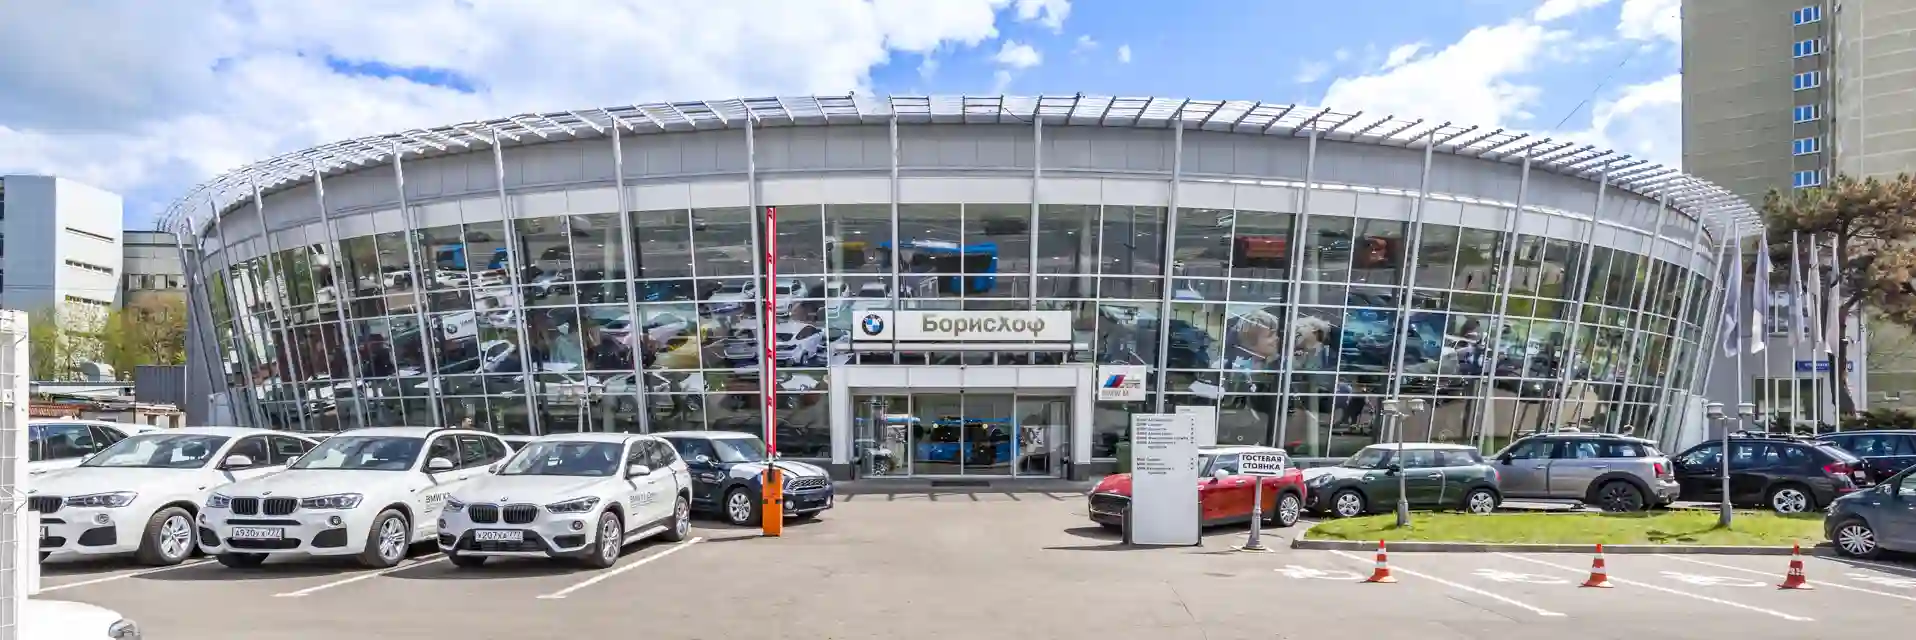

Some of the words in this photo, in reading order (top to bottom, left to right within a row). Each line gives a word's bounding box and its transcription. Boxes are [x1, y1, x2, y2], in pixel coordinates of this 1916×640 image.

[921, 313, 1045, 337] БорисХоф
[1242, 454, 1282, 463] ГОСТЕВАЯ
[1242, 463, 1281, 471] СТОЯНКА
[425, 492, 441, 503] BMW
